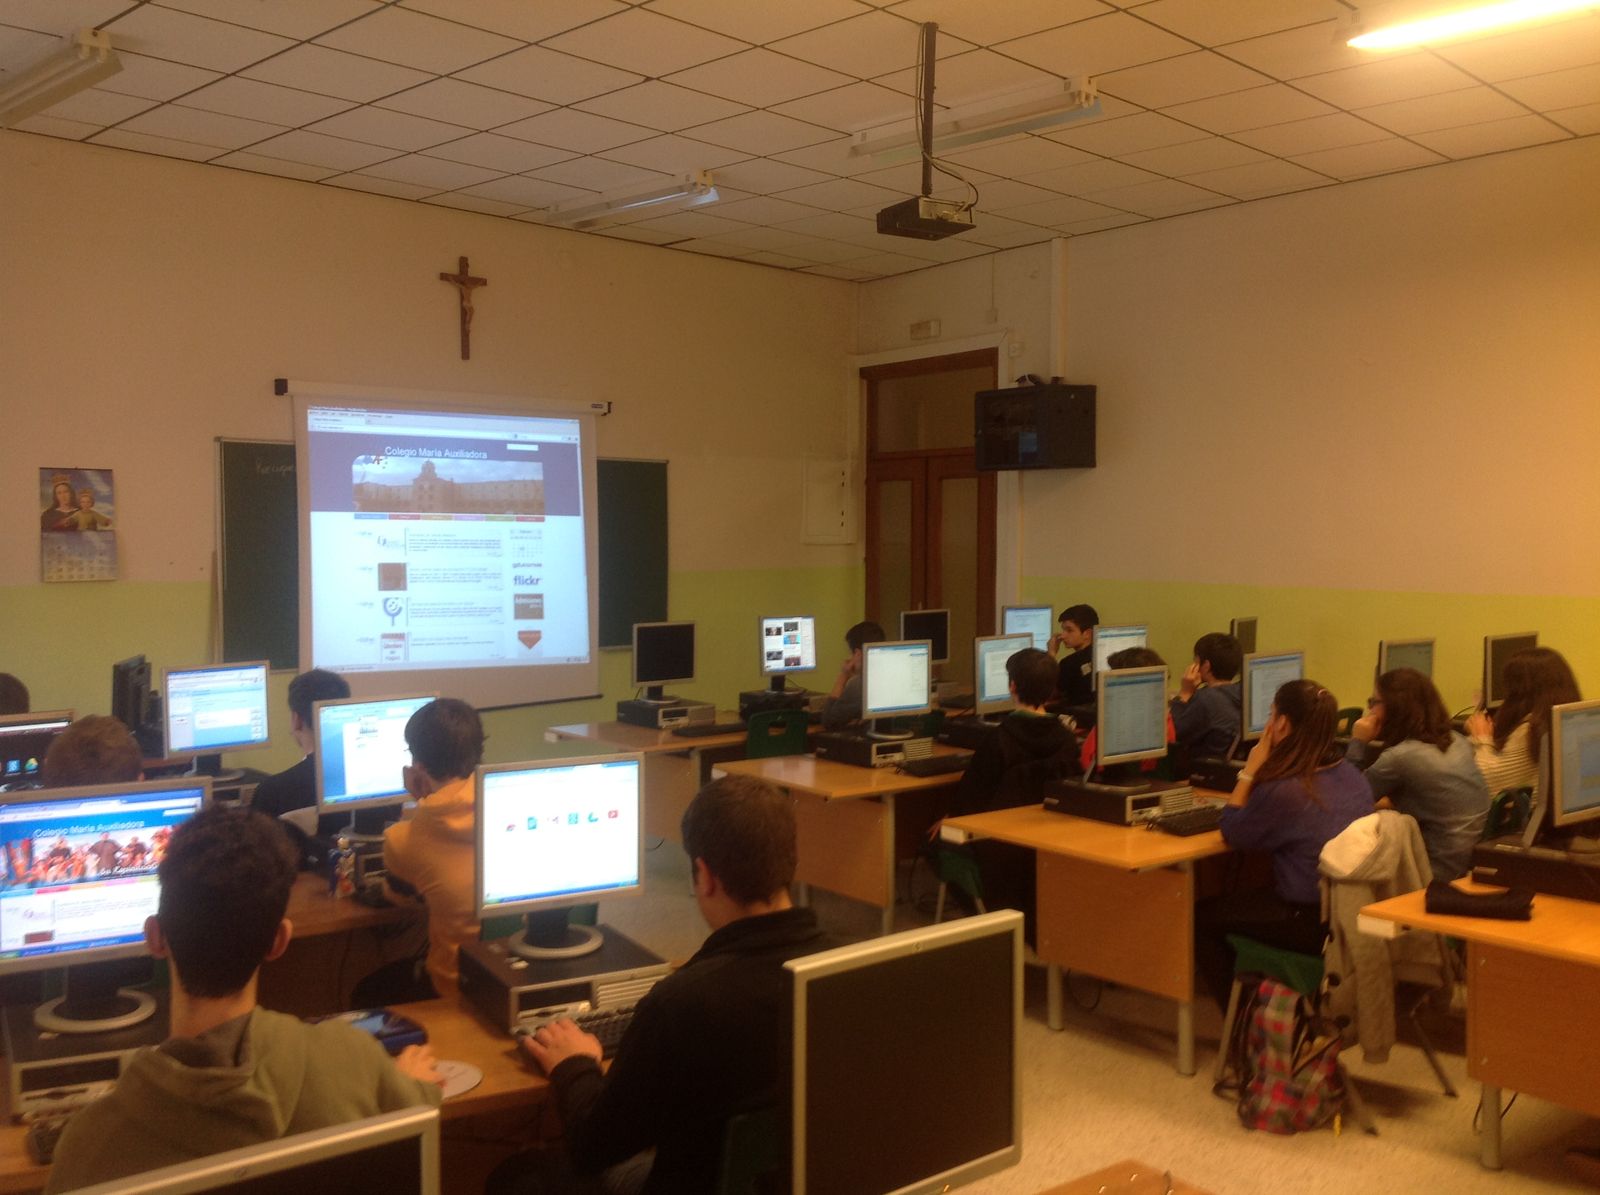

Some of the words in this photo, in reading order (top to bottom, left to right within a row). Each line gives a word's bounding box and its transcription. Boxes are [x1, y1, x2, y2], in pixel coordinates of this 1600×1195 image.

[384, 446, 417, 457] Colegio
[444, 449, 487, 459] Auxiliadora
[513, 575, 541, 586] flickr
